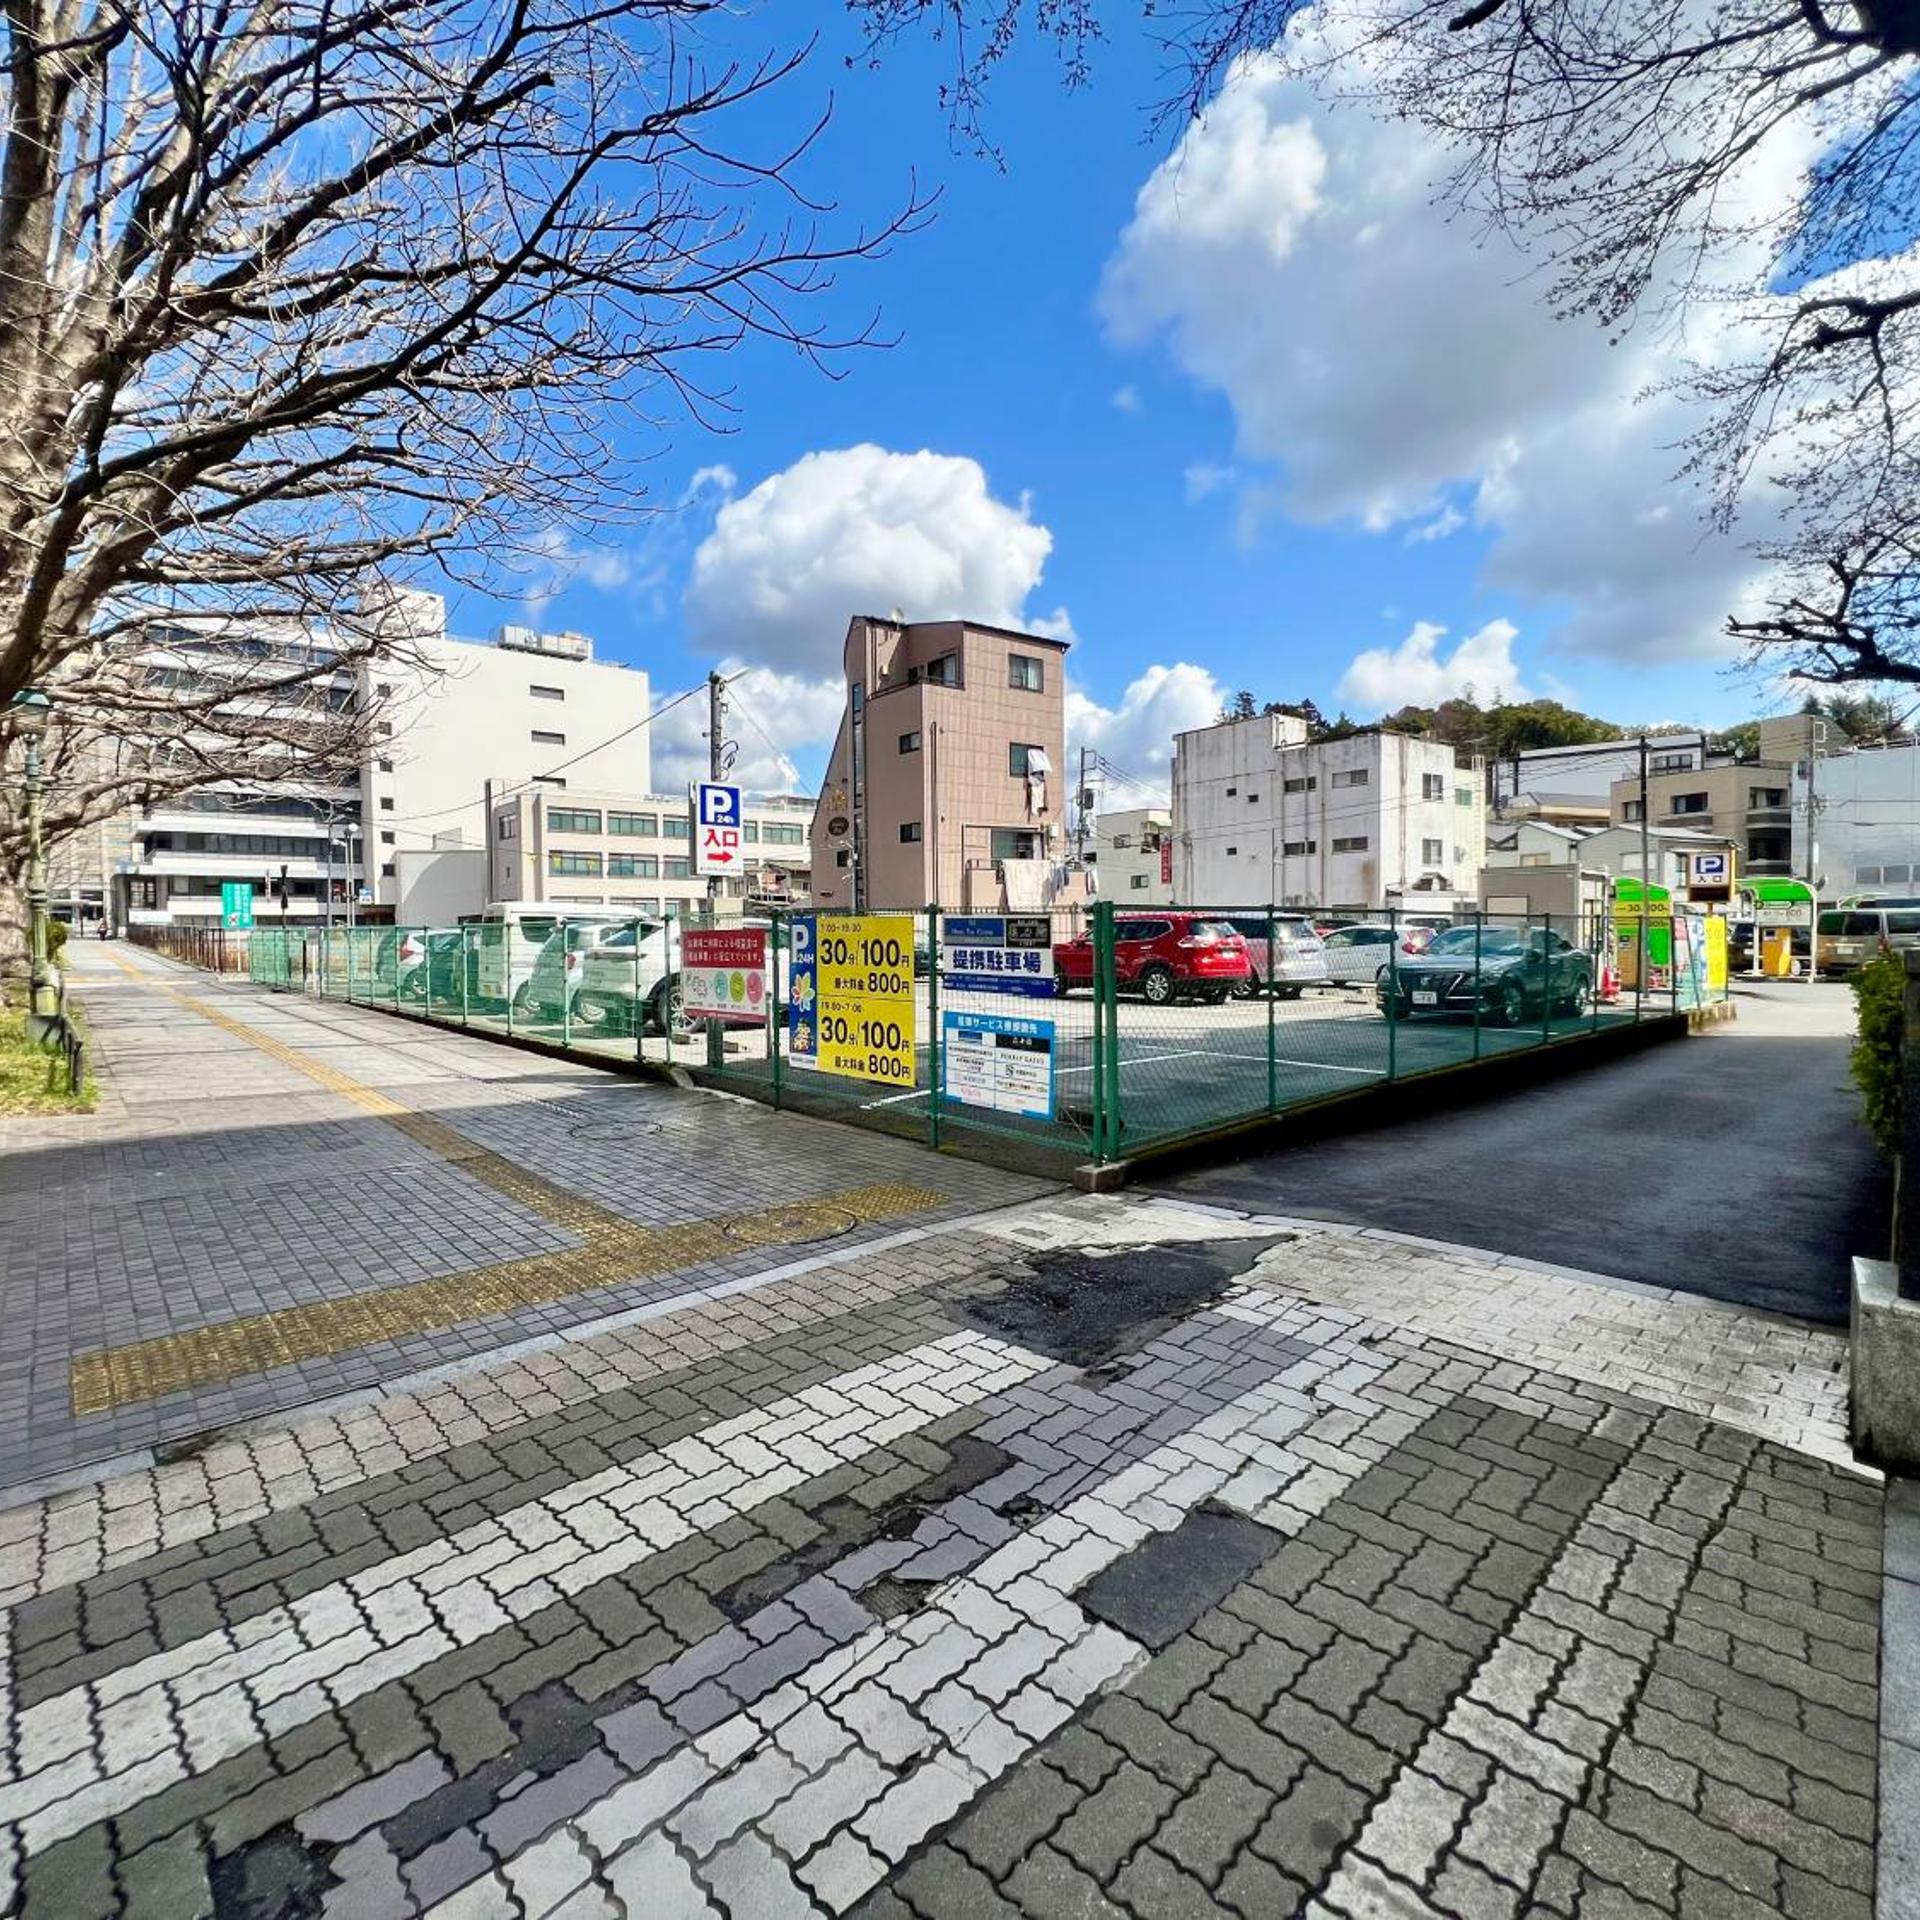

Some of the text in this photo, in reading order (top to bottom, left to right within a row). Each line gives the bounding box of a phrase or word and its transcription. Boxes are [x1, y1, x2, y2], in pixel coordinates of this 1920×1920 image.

[705, 788, 732, 823] P
[704, 829, 739, 848] 入口
[1699, 856, 1722, 874] P
[1697, 875, 1722, 883] 入口
[791, 924, 809, 963] P
[952, 949, 1042, 974] 提携駐車場
